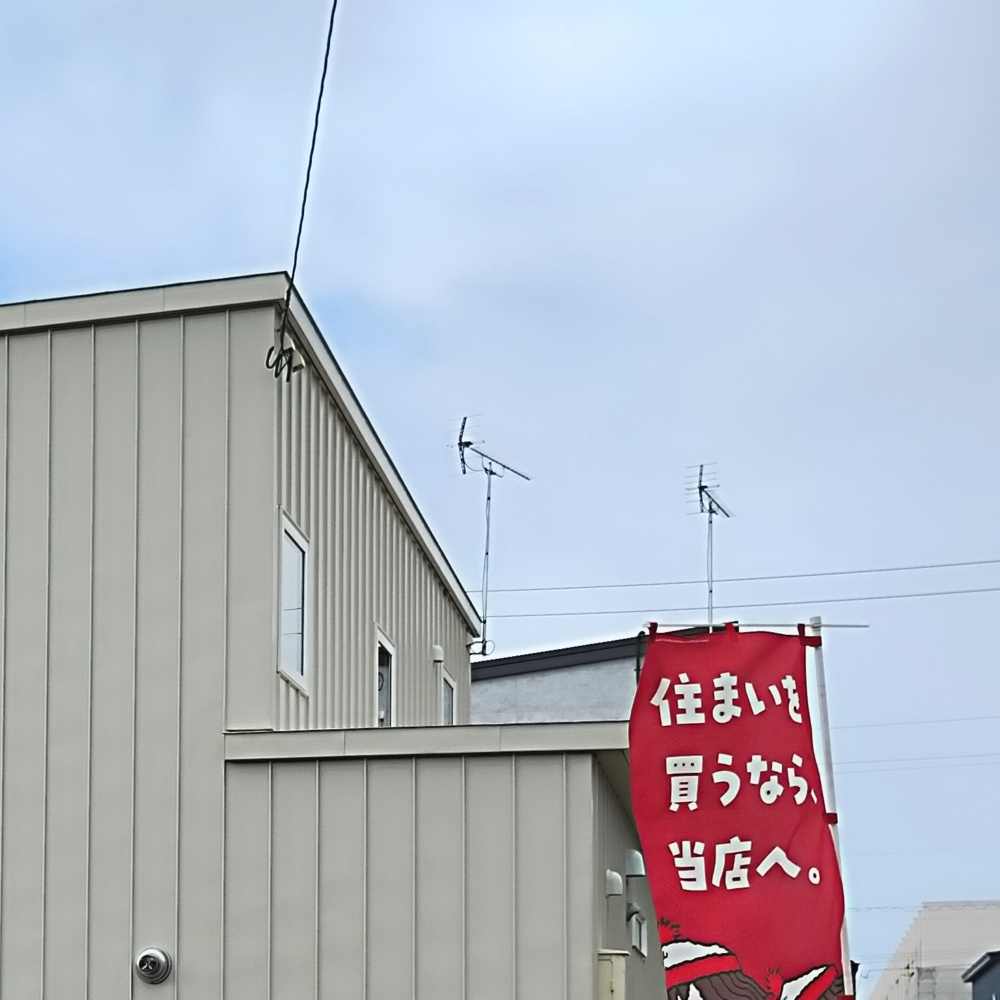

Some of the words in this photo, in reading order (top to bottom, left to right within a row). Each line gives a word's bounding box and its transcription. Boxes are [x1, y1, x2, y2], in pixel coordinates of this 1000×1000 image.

[650, 672, 803, 726] 住まいを
[668, 836, 821, 891] 当店へ。
